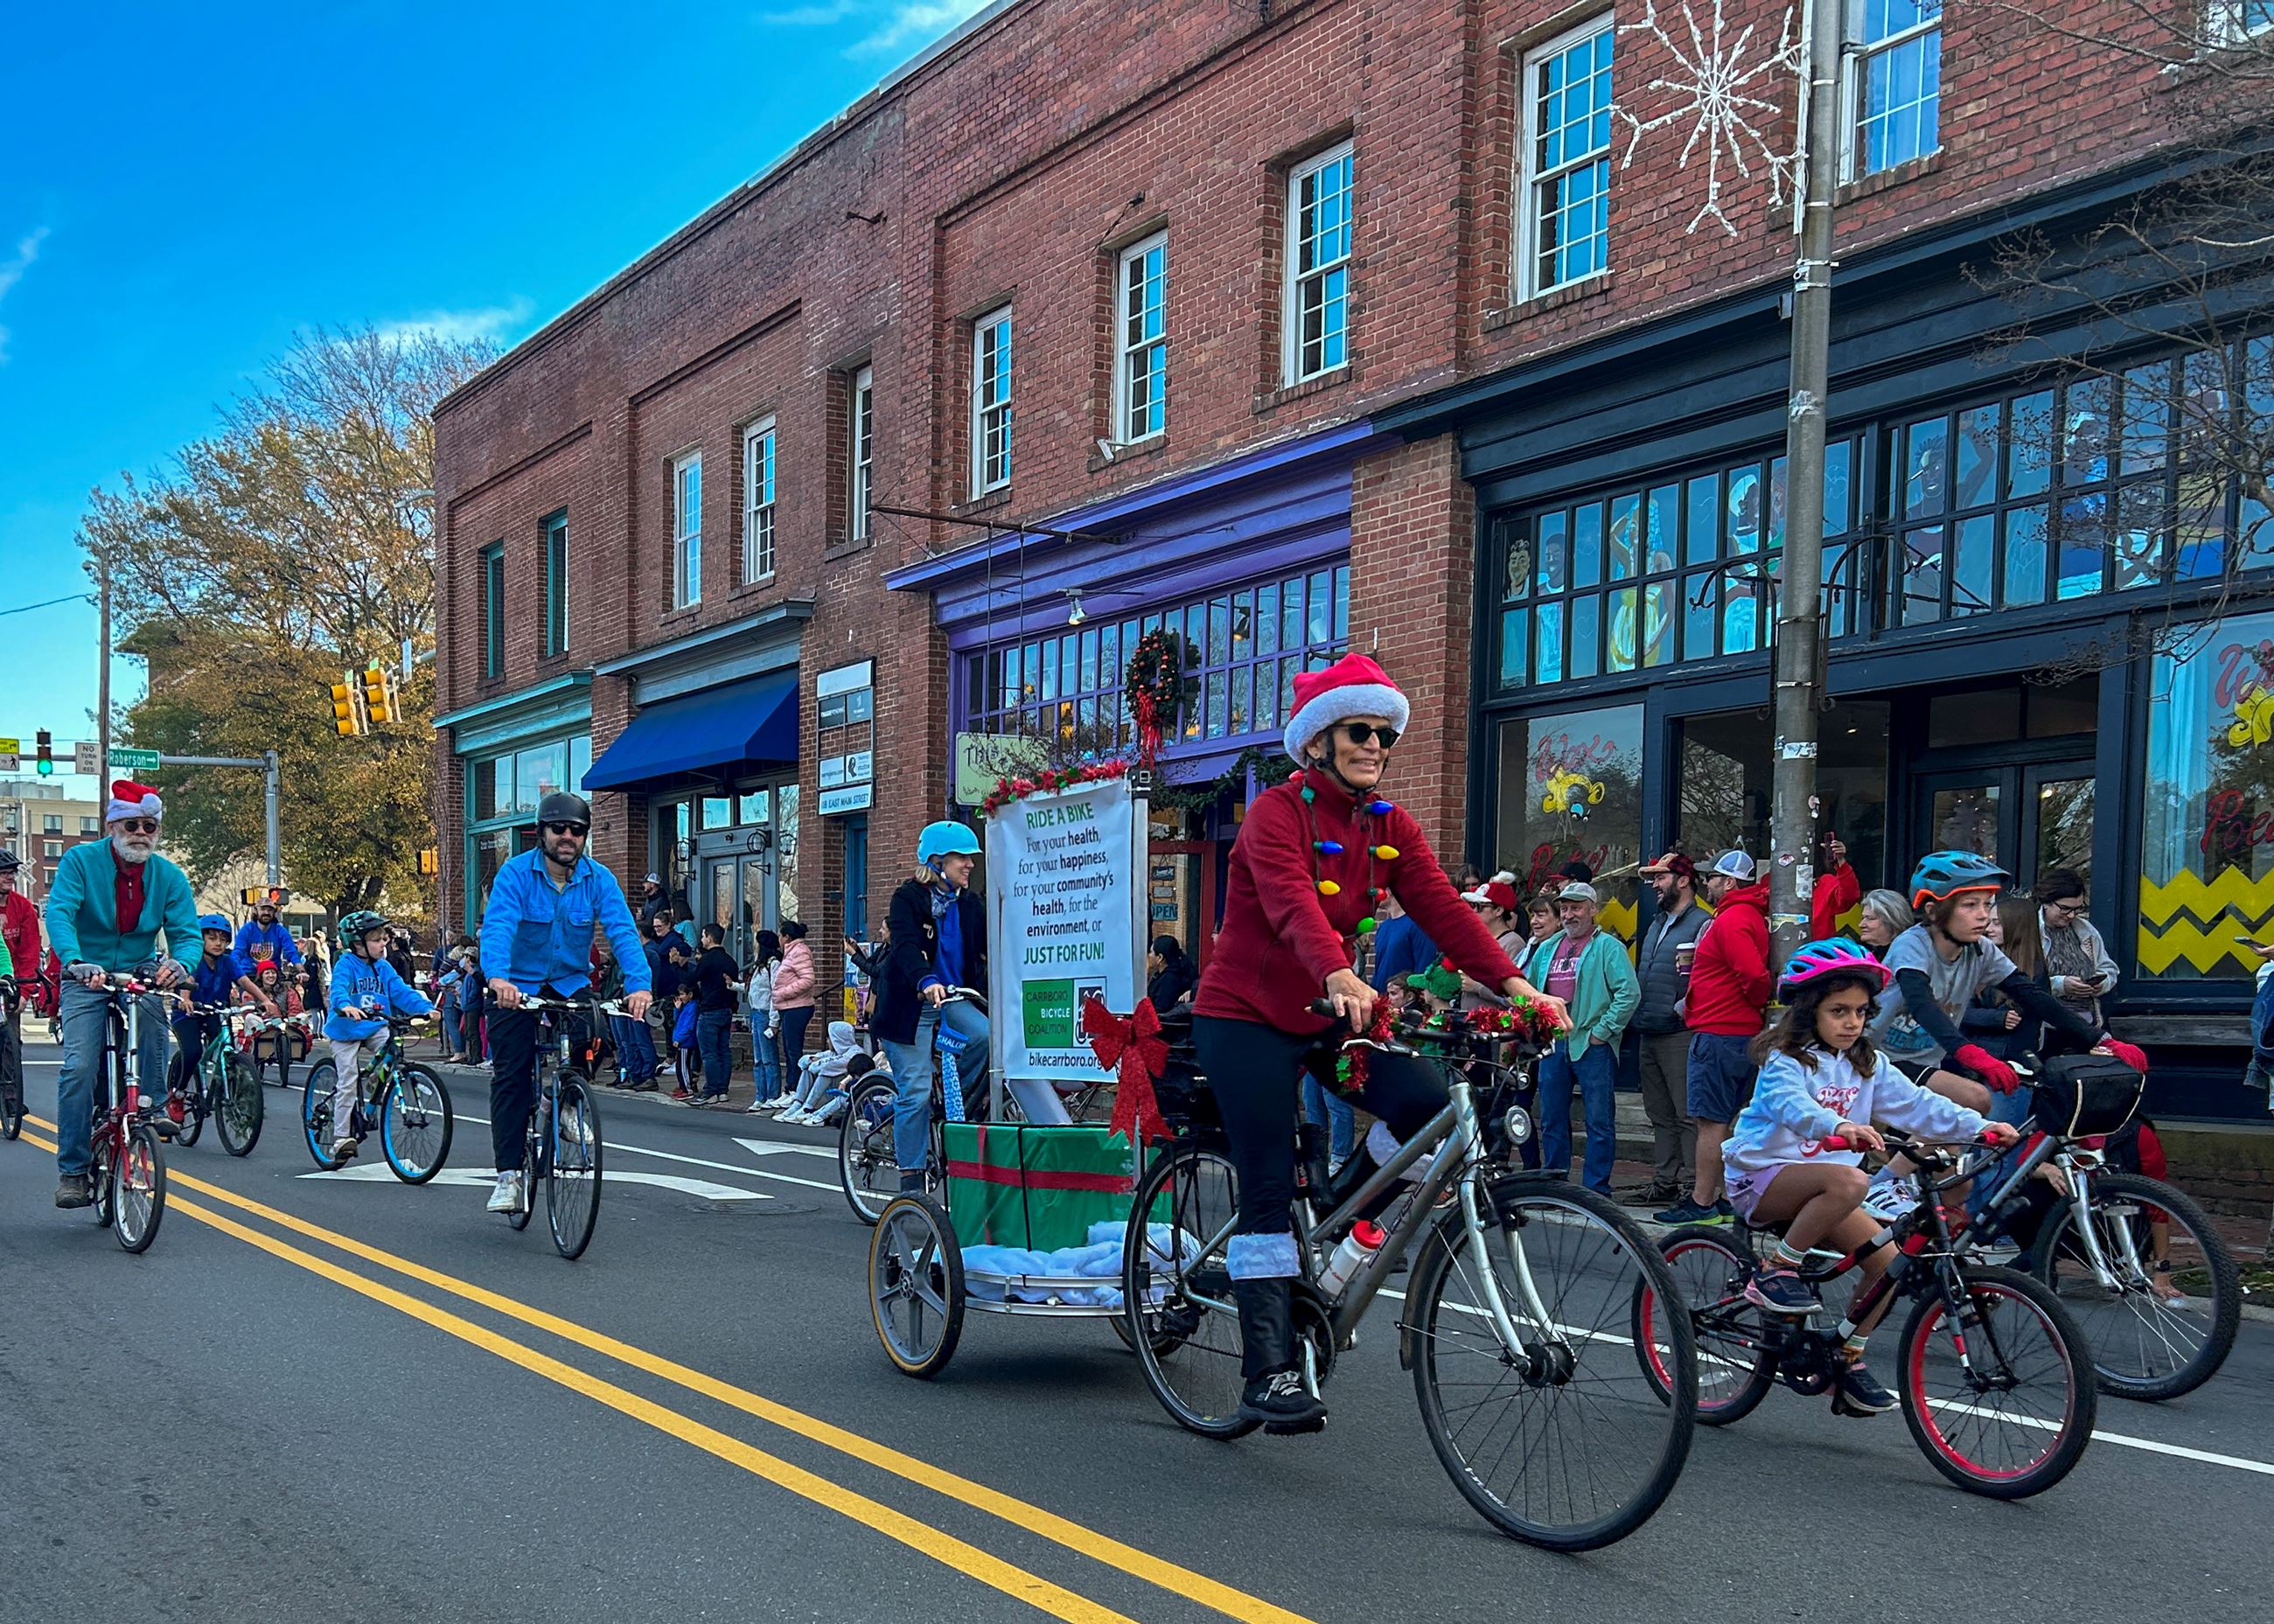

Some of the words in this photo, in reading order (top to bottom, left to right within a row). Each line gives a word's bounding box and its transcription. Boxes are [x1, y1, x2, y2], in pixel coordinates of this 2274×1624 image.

[109, 750, 147, 767] Roberson
[828, 798, 840, 809] EAST
[841, 795, 852, 806] MAIN
[853, 792, 868, 805] STREET
[1026, 809, 1055, 830] RIDE
[1057, 807, 1066, 825] A
[1065, 802, 1094, 823] BIKE
[1027, 837, 1043, 854] For
[1042, 836, 1066, 856] your
[1067, 826, 1101, 846] health,
[1018, 858, 1034, 875] for
[1036, 859, 1058, 878] your
[1059, 851, 1109, 872] happiness,
[1014, 882, 1029, 897] for
[1030, 882, 1055, 901] your
[1057, 870, 1113, 893] community's
[1032, 898, 1067, 917] health,
[1068, 896, 1082, 913] for
[1084, 893, 1099, 911] the
[1027, 918, 1090, 937] environment,
[1092, 919, 1102, 932] or
[1023, 946, 1055, 965] JUST
[1057, 944, 1078, 963] FOR
[1079, 941, 1105, 961] FUN!
[1025, 990, 1069, 1003] CARRBORO
[1041, 1007, 1071, 1019] BICYCLE
[1028, 1023, 1067, 1035] COALITION
[937, 1034, 967, 1050] SHALOM
[1029, 1051, 1102, 1070] bikecarrboro.org
